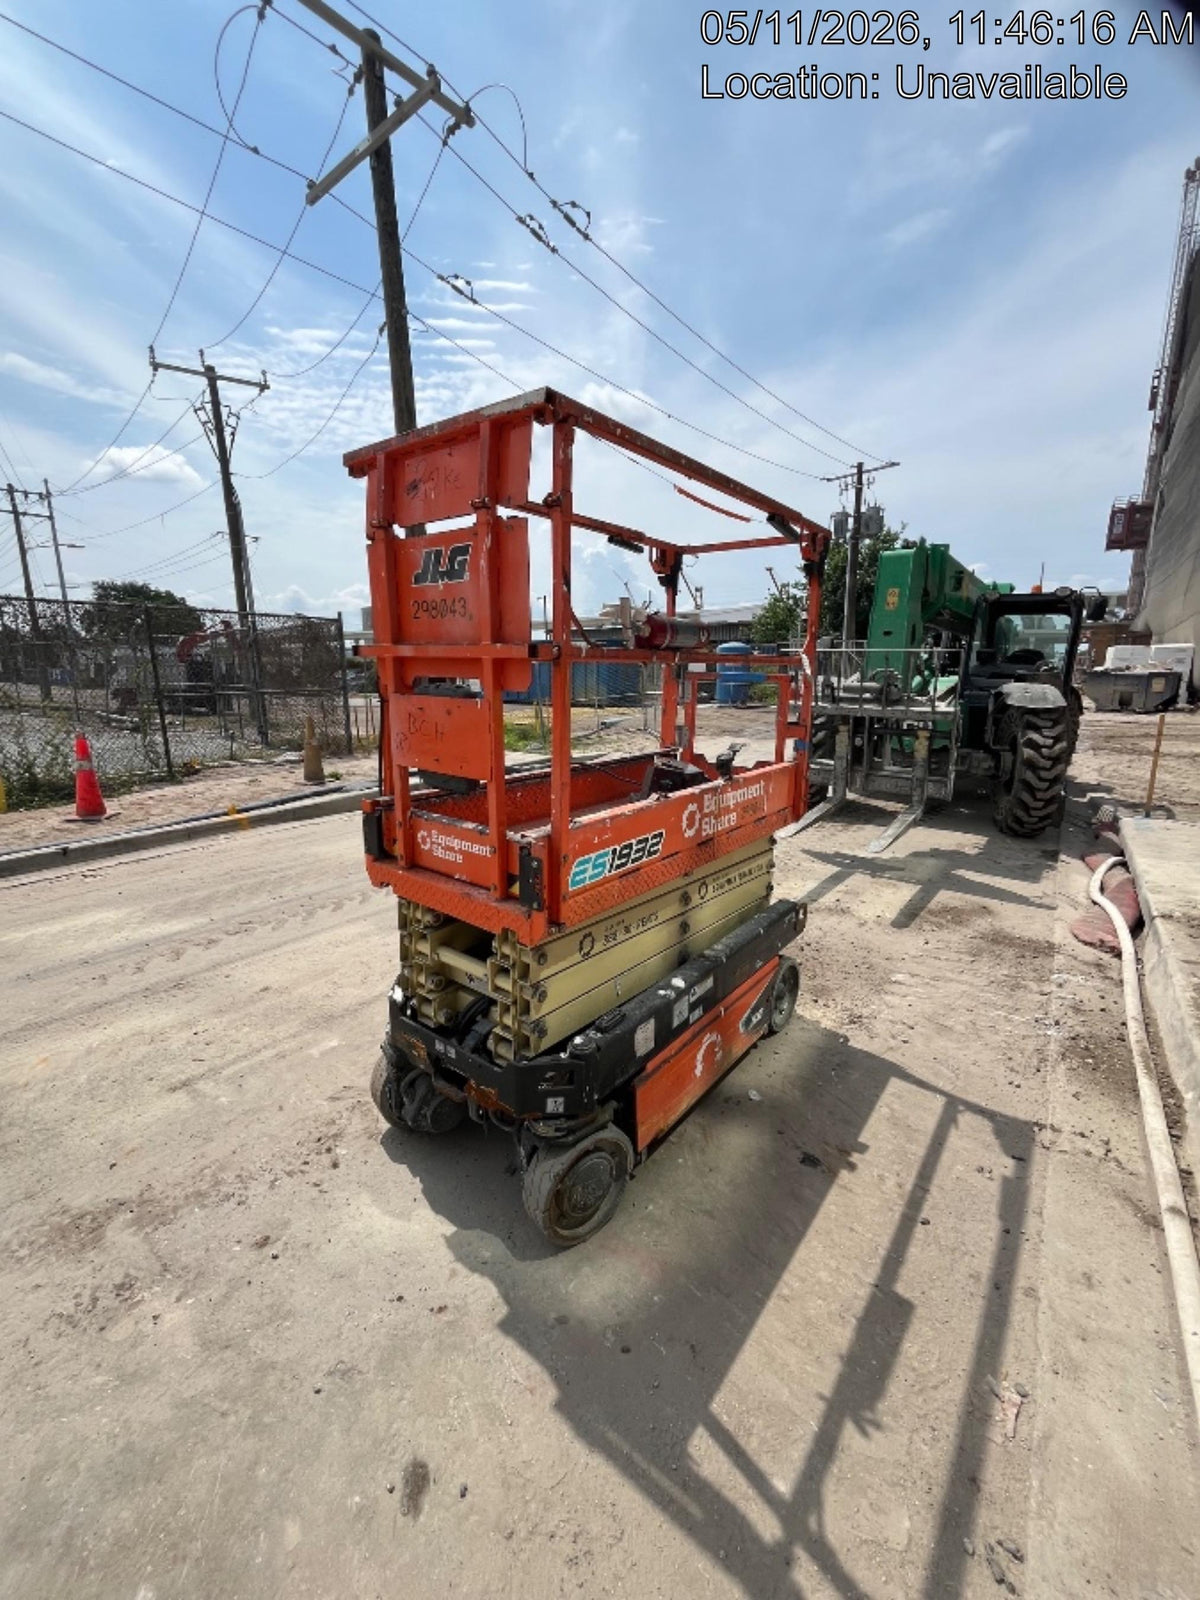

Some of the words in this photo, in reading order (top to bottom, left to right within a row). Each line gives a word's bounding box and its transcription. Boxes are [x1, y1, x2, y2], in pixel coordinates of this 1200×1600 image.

[411, 542, 473, 588] JLG
[703, 780, 765, 814] Equipment
[702, 812, 737, 836] Share
[431, 829, 492, 858] Equipment
[431, 843, 463, 863] Share
[569, 828, 665, 891] ES1932
